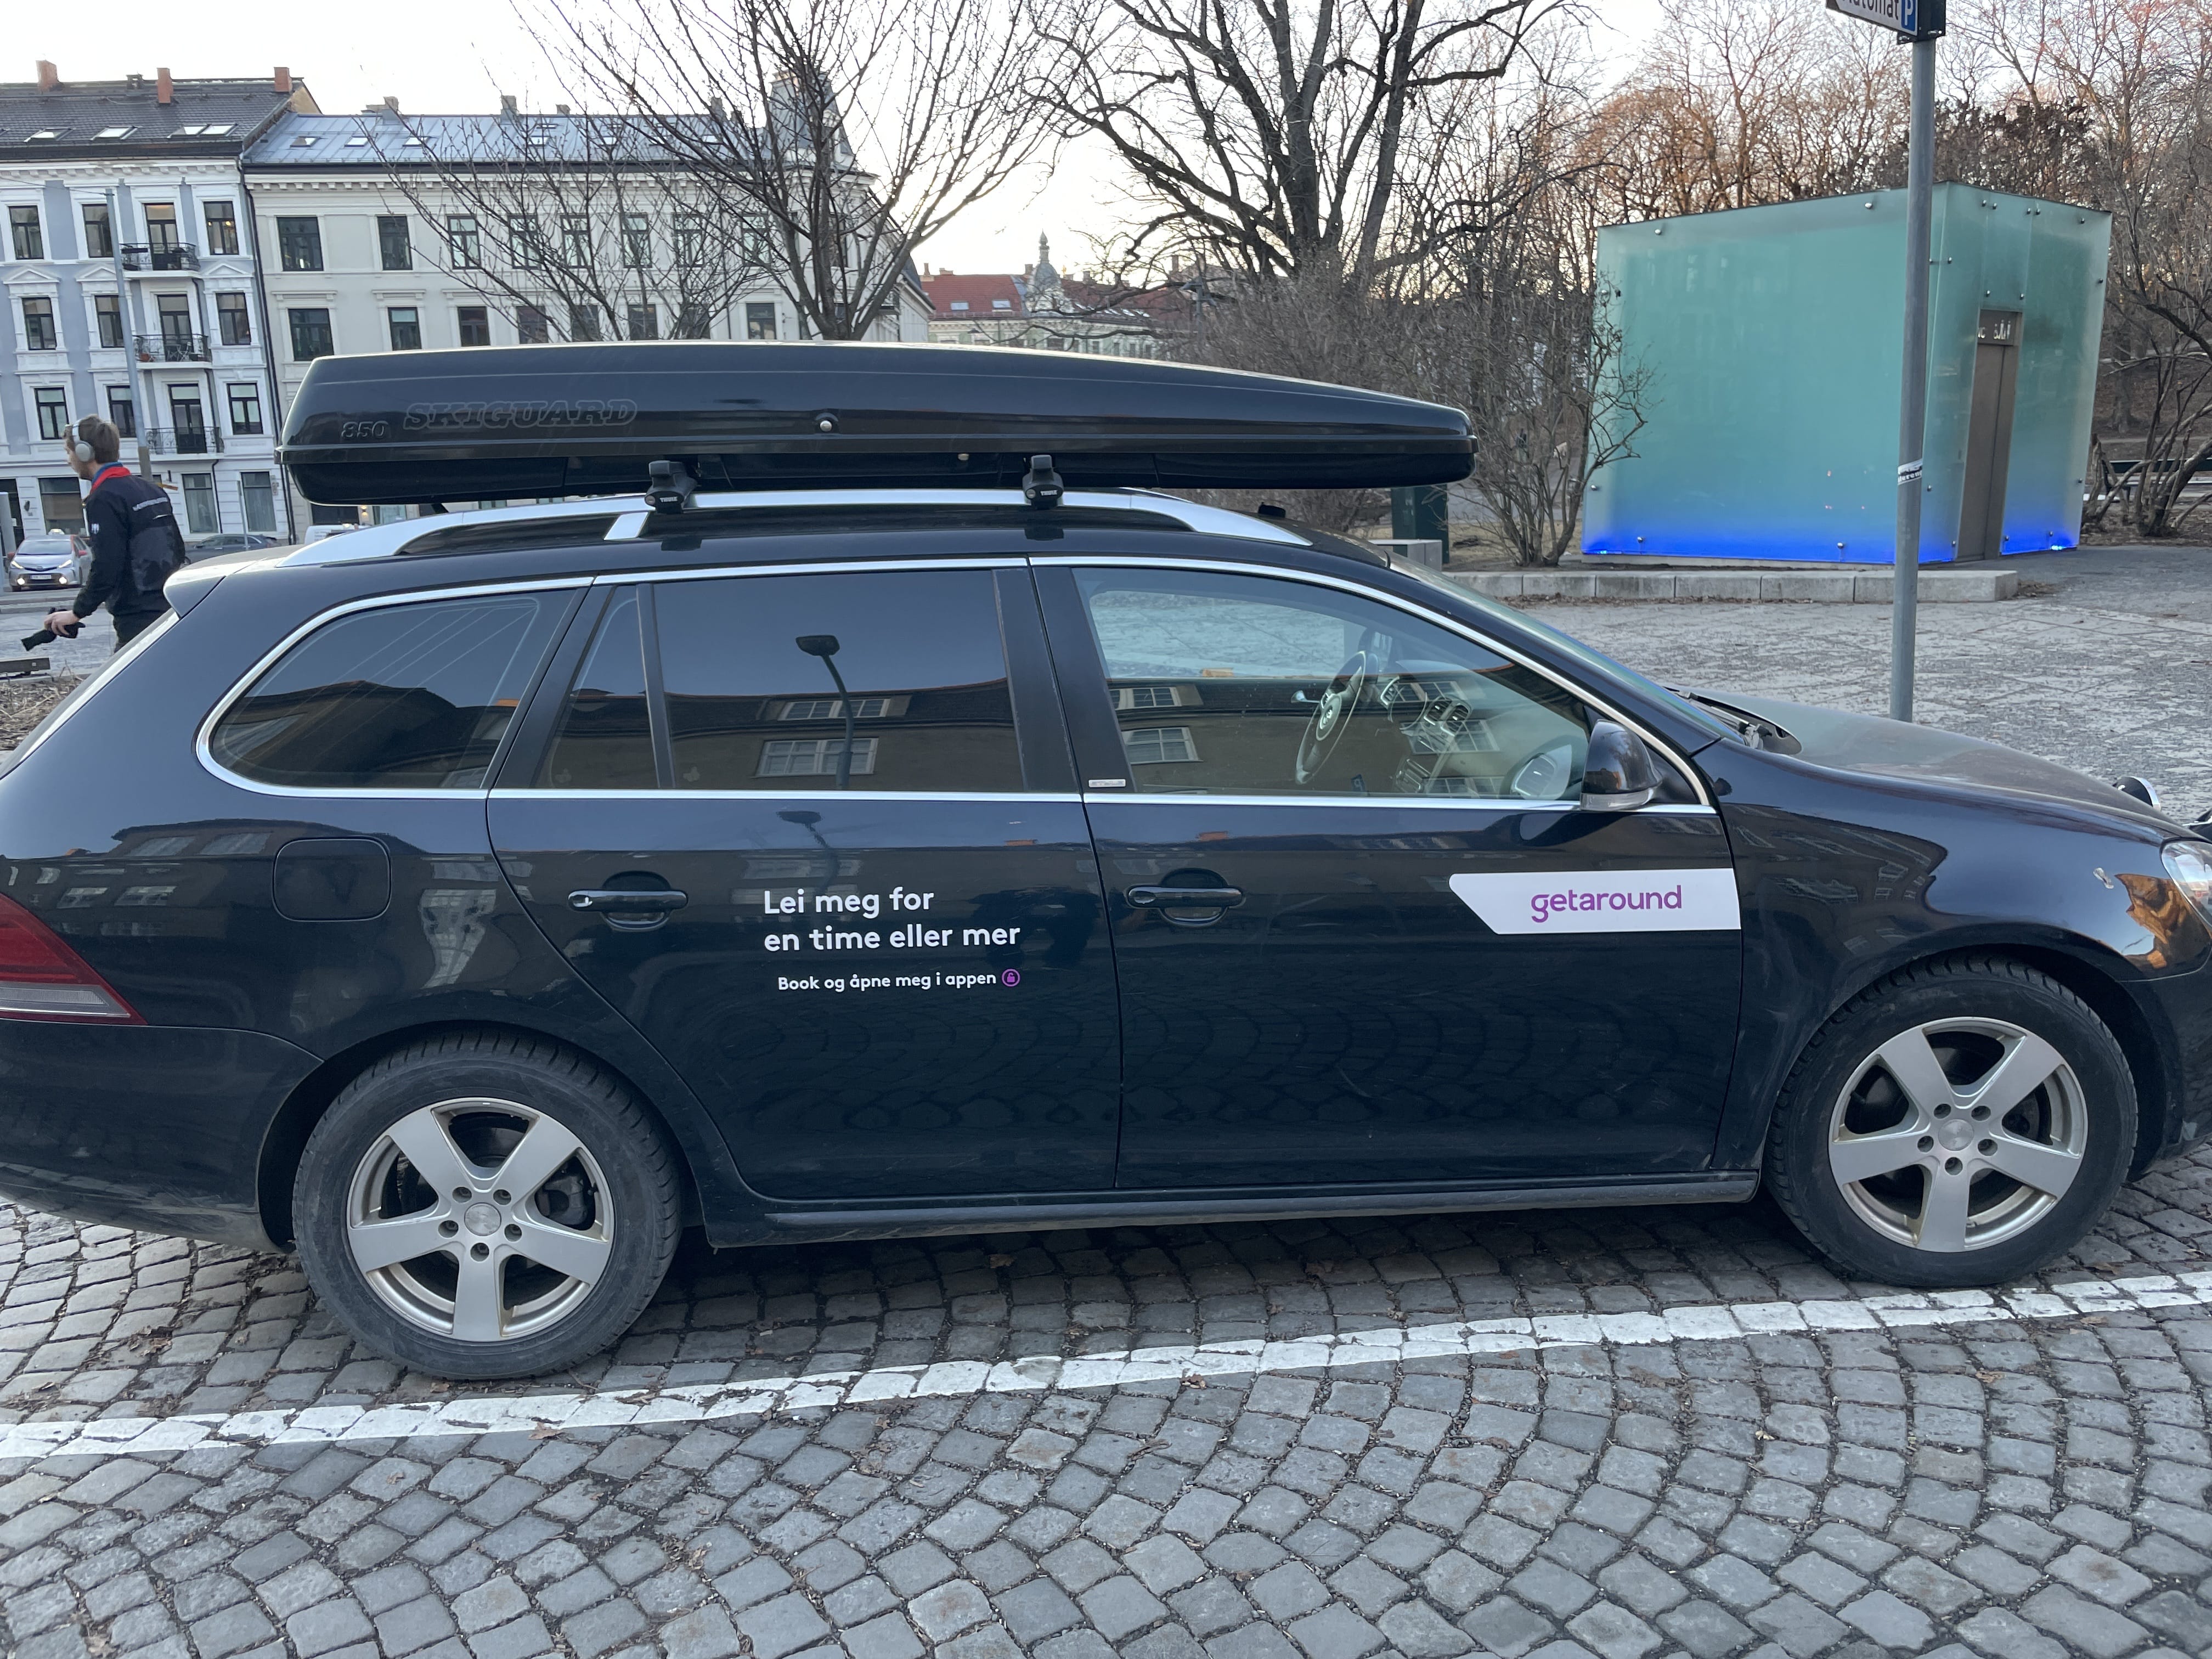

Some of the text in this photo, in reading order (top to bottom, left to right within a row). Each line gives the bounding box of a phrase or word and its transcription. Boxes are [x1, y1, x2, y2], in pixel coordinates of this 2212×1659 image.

[1842, 0, 1899, 20] omat
[403, 399, 637, 430] SKIGUARD
[341, 420, 389, 438] 850
[764, 886, 935, 919] Lei meg for
[1531, 885, 1682, 923] getaround
[764, 923, 1020, 951] en time eller mer
[778, 972, 996, 992] Book og åpne meg i appen
